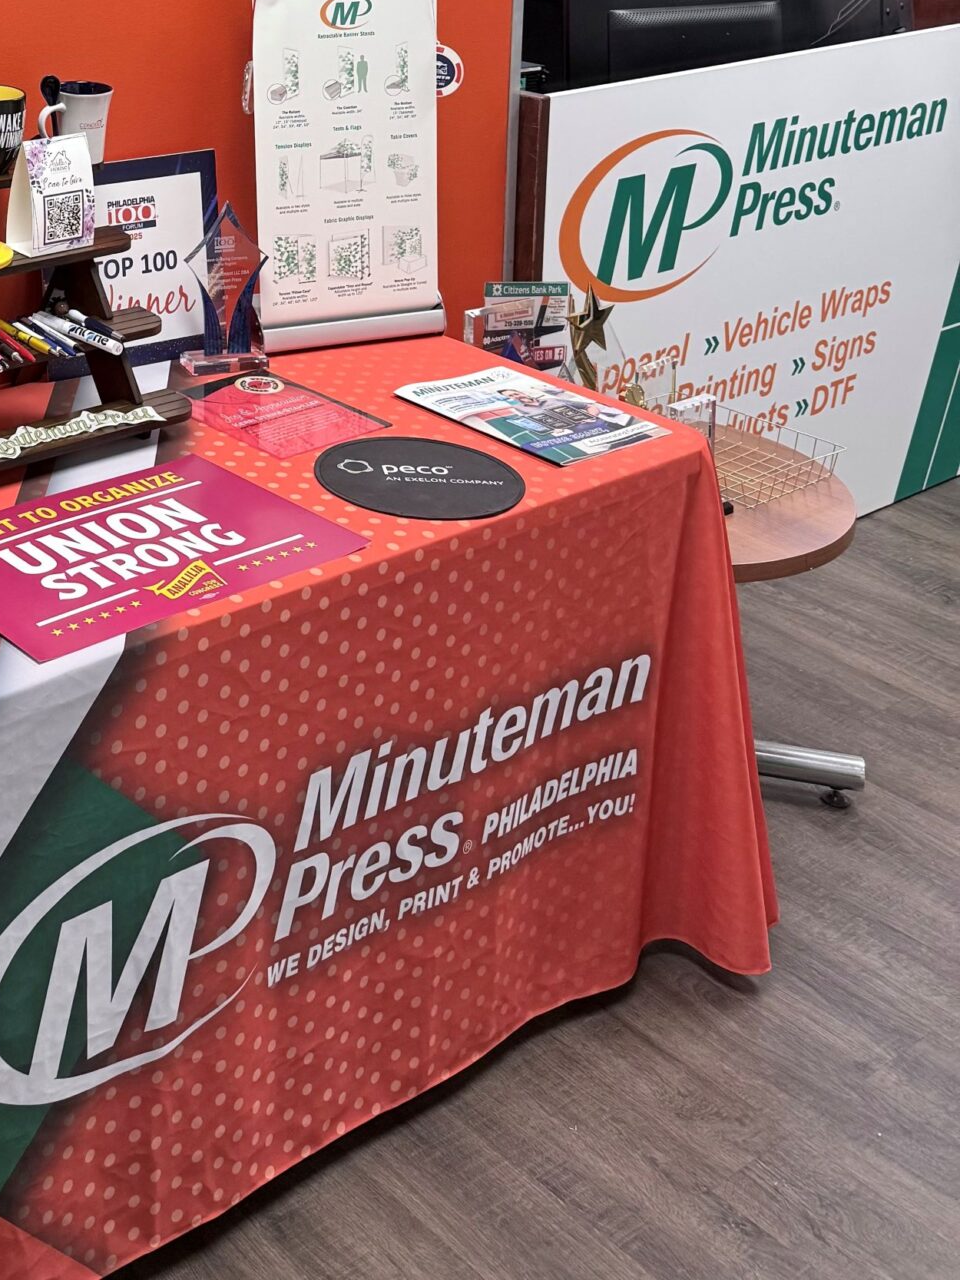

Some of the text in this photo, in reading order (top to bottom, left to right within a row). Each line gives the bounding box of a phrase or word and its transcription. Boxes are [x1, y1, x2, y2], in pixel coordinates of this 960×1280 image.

[742, 96, 948, 177] Minuteman
[107, 196, 155, 209] PHILADELPHIA
[141, 250, 177, 274] 100
[503, 285, 562, 295] Citizens Bank Park
[724, 278, 893, 353] Vehicle Wraps
[811, 329, 878, 373] Signs
[411, 376, 495, 398] MINUTEMAN
[810, 374, 857, 416] DTF
[17, 506, 58, 525] TO
[64, 471, 185, 514] ORGANIZE
[385, 475, 503, 486] AN EXELON COMPANY
[40, 522, 246, 600] STRONG
[167, 563, 205, 598] ANALILIA
[294, 654, 651, 852] Minuteman
[481, 748, 638, 844] PHILADELPHIA
[266, 957, 301, 987] WE
[306, 911, 392, 962] DESIGN,
[397, 876, 462, 919] PRINT
[466, 867, 479, 888] &
